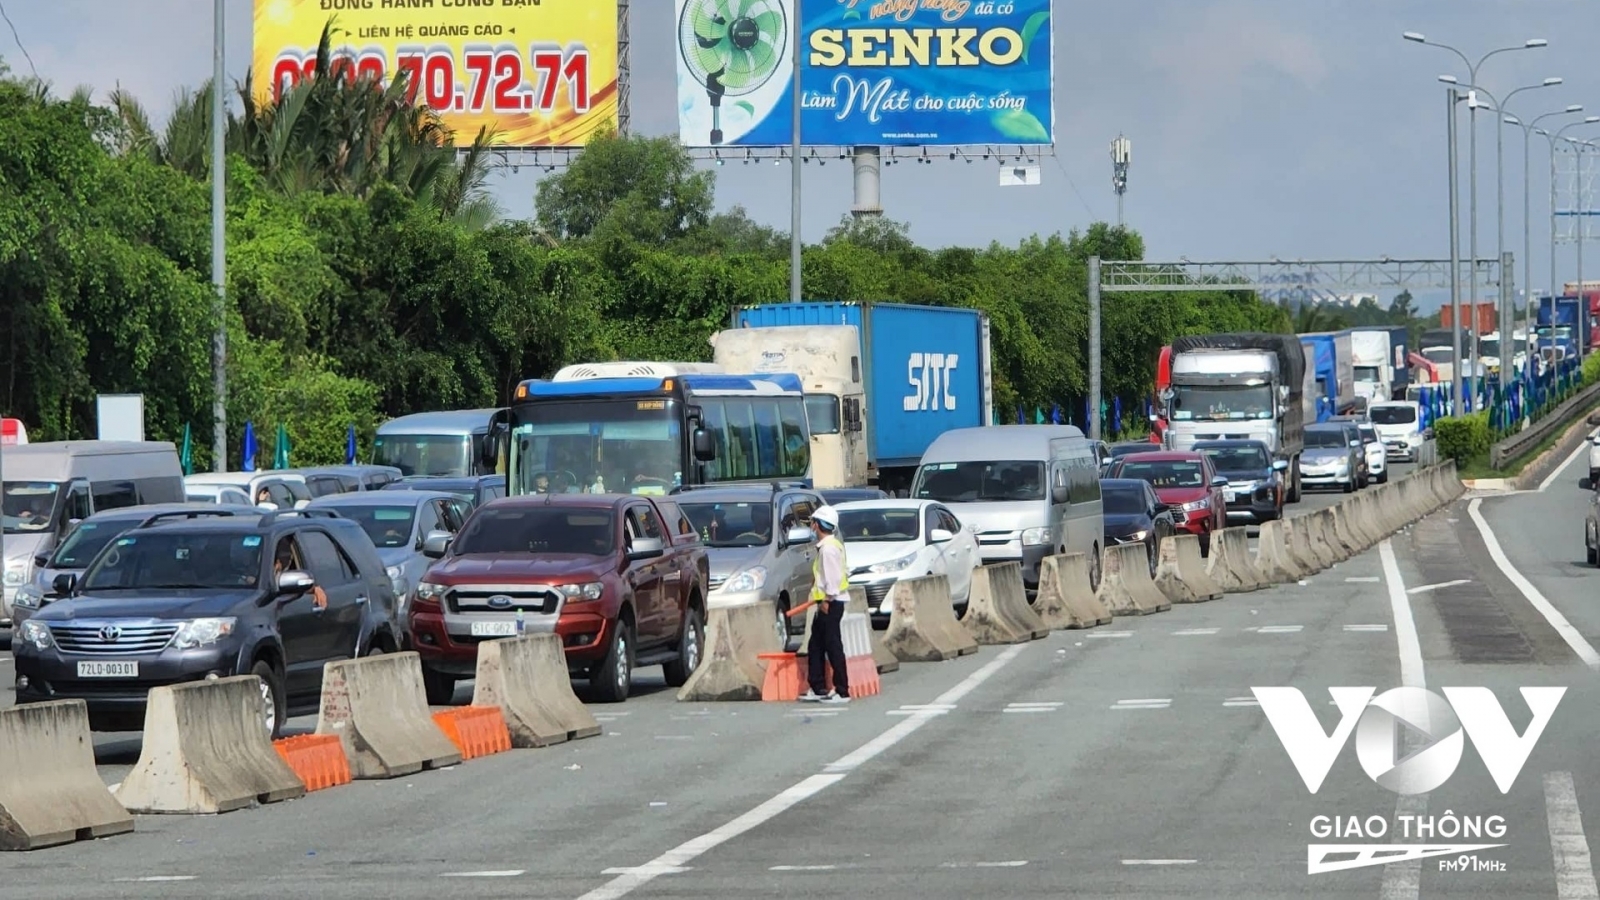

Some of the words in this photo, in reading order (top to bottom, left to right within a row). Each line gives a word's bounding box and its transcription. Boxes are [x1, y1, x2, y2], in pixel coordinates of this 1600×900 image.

[974, 1, 993, 15] đã
[997, 1, 1015, 15] có
[359, 25, 390, 38] LIÊN
[395, 24, 414, 39] HỆ
[418, 22, 469, 37] QUẢNG
[474, 22, 503, 36] CÁO
[809, 27, 1024, 67] SENKO
[801, 92, 836, 108] Làm
[832, 74, 910, 123] Mát
[914, 95, 943, 111] cho
[947, 95, 984, 113] cuộc
[988, 91, 1026, 111] sống
[903, 352, 959, 411] SITC
